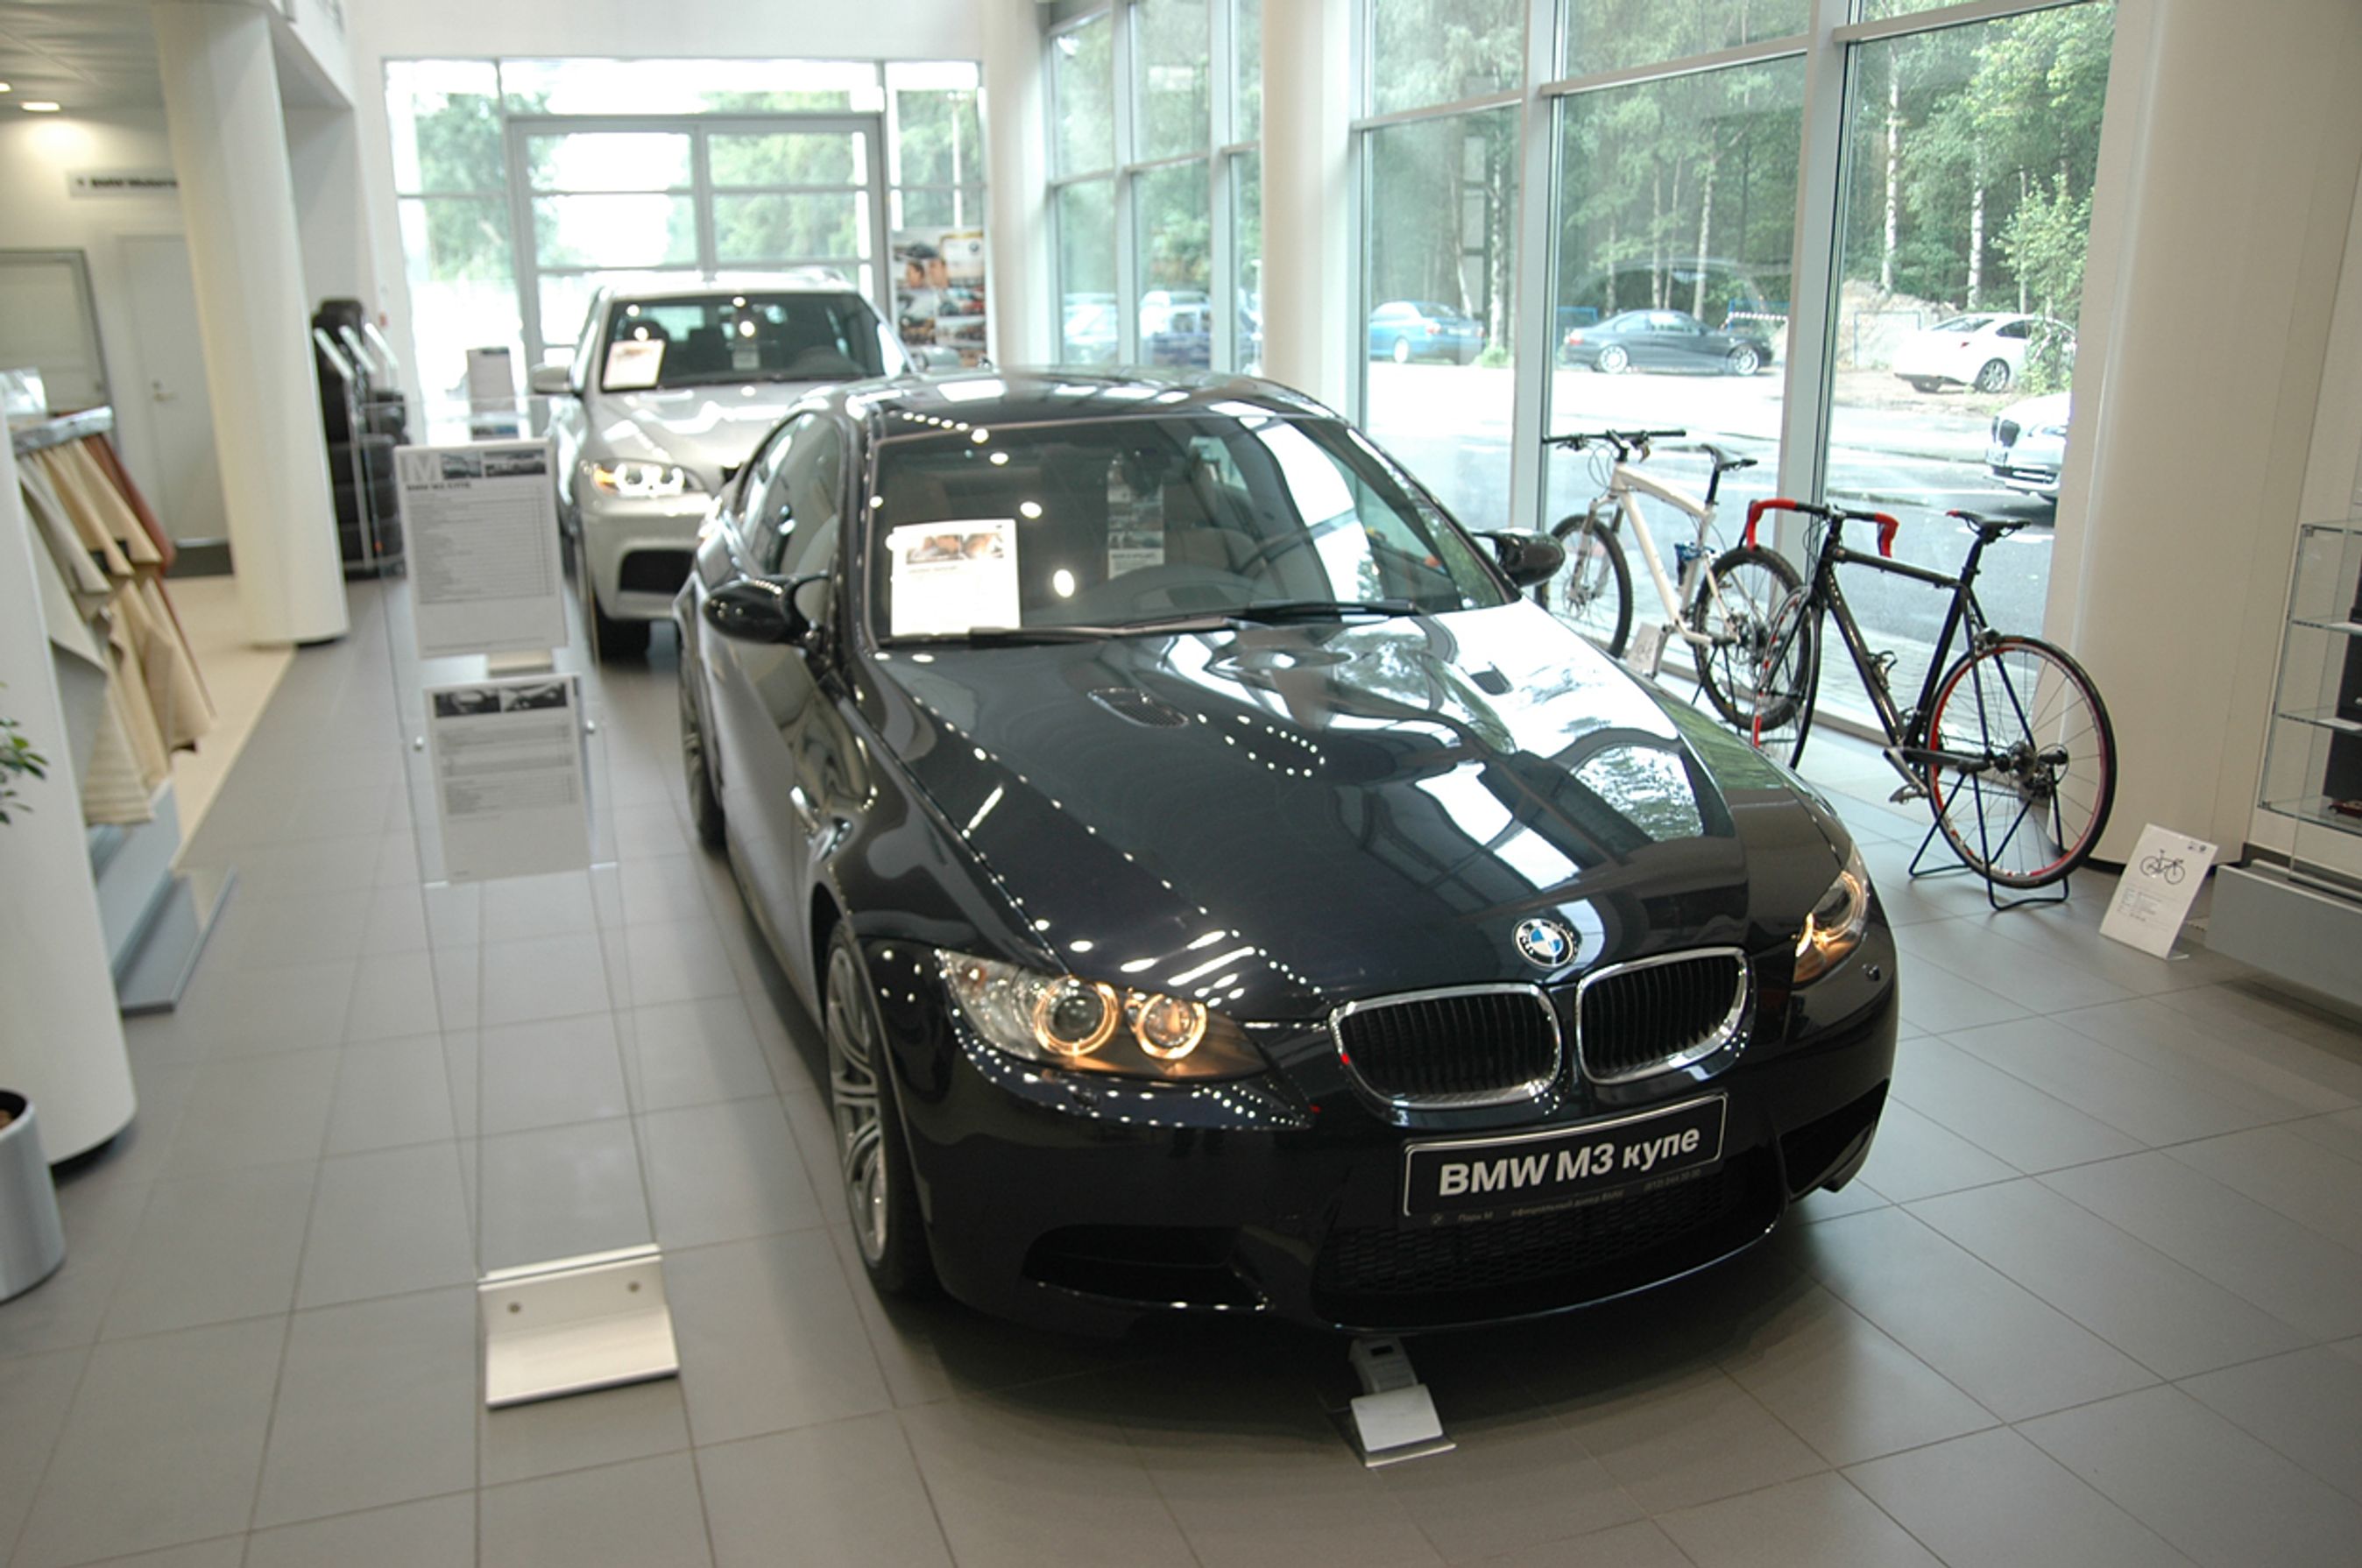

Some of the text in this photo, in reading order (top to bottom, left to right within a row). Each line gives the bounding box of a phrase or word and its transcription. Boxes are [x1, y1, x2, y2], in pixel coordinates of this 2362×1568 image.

[1439, 1153, 1550, 1197] BMW
[1556, 1142, 1614, 1182] M3
[1623, 1128, 1701, 1172] купе
